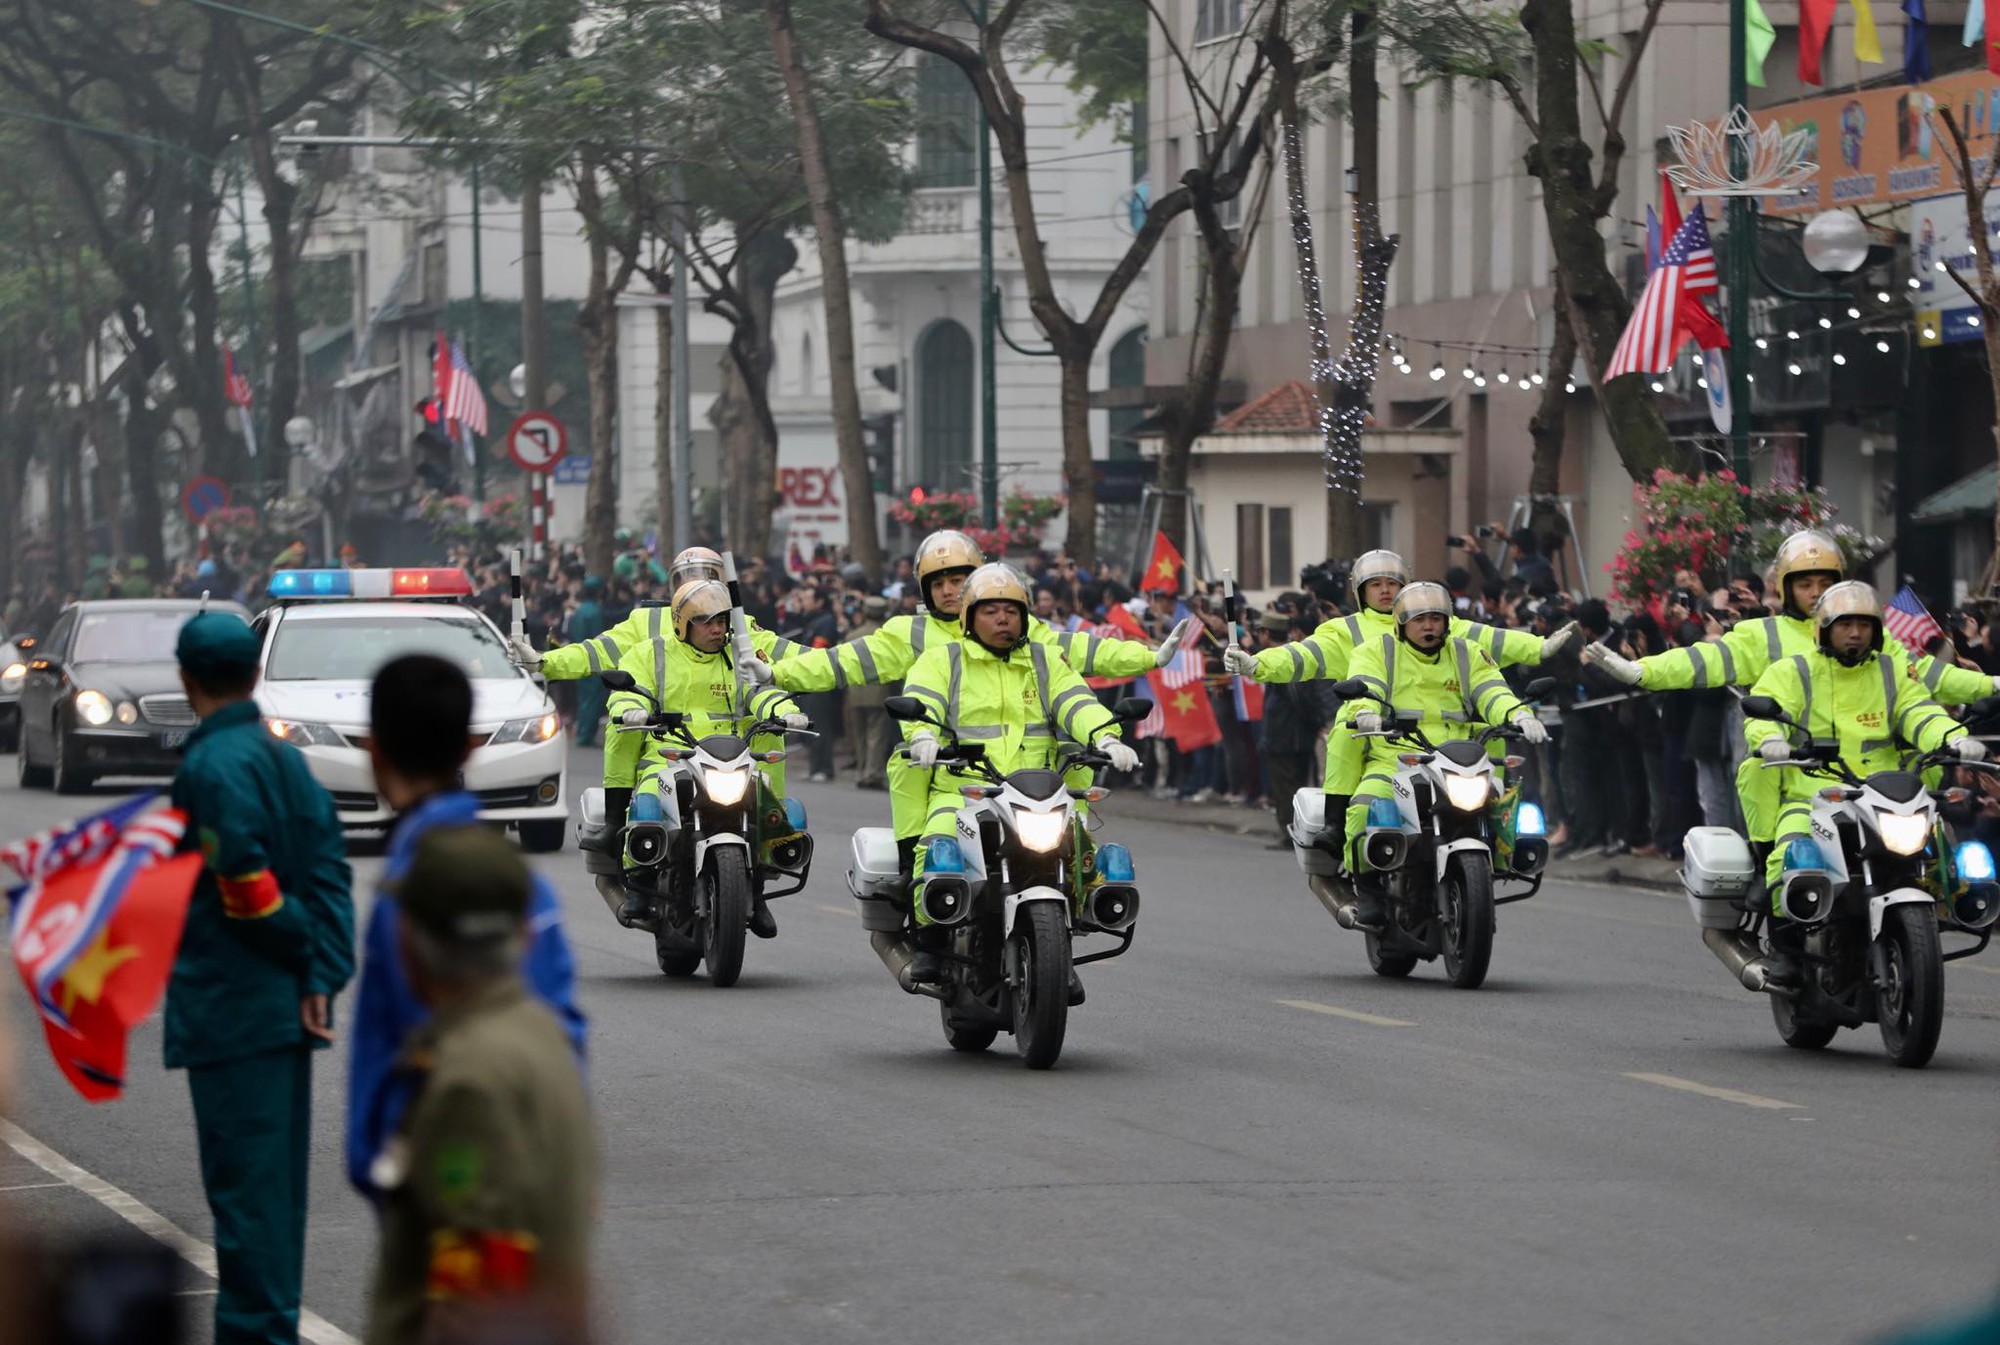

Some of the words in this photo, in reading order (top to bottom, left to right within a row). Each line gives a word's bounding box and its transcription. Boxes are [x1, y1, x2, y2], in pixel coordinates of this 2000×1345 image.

[781, 467, 840, 508] REX
[956, 817, 977, 840] POLICE
[1811, 819, 1835, 841] POLICE
